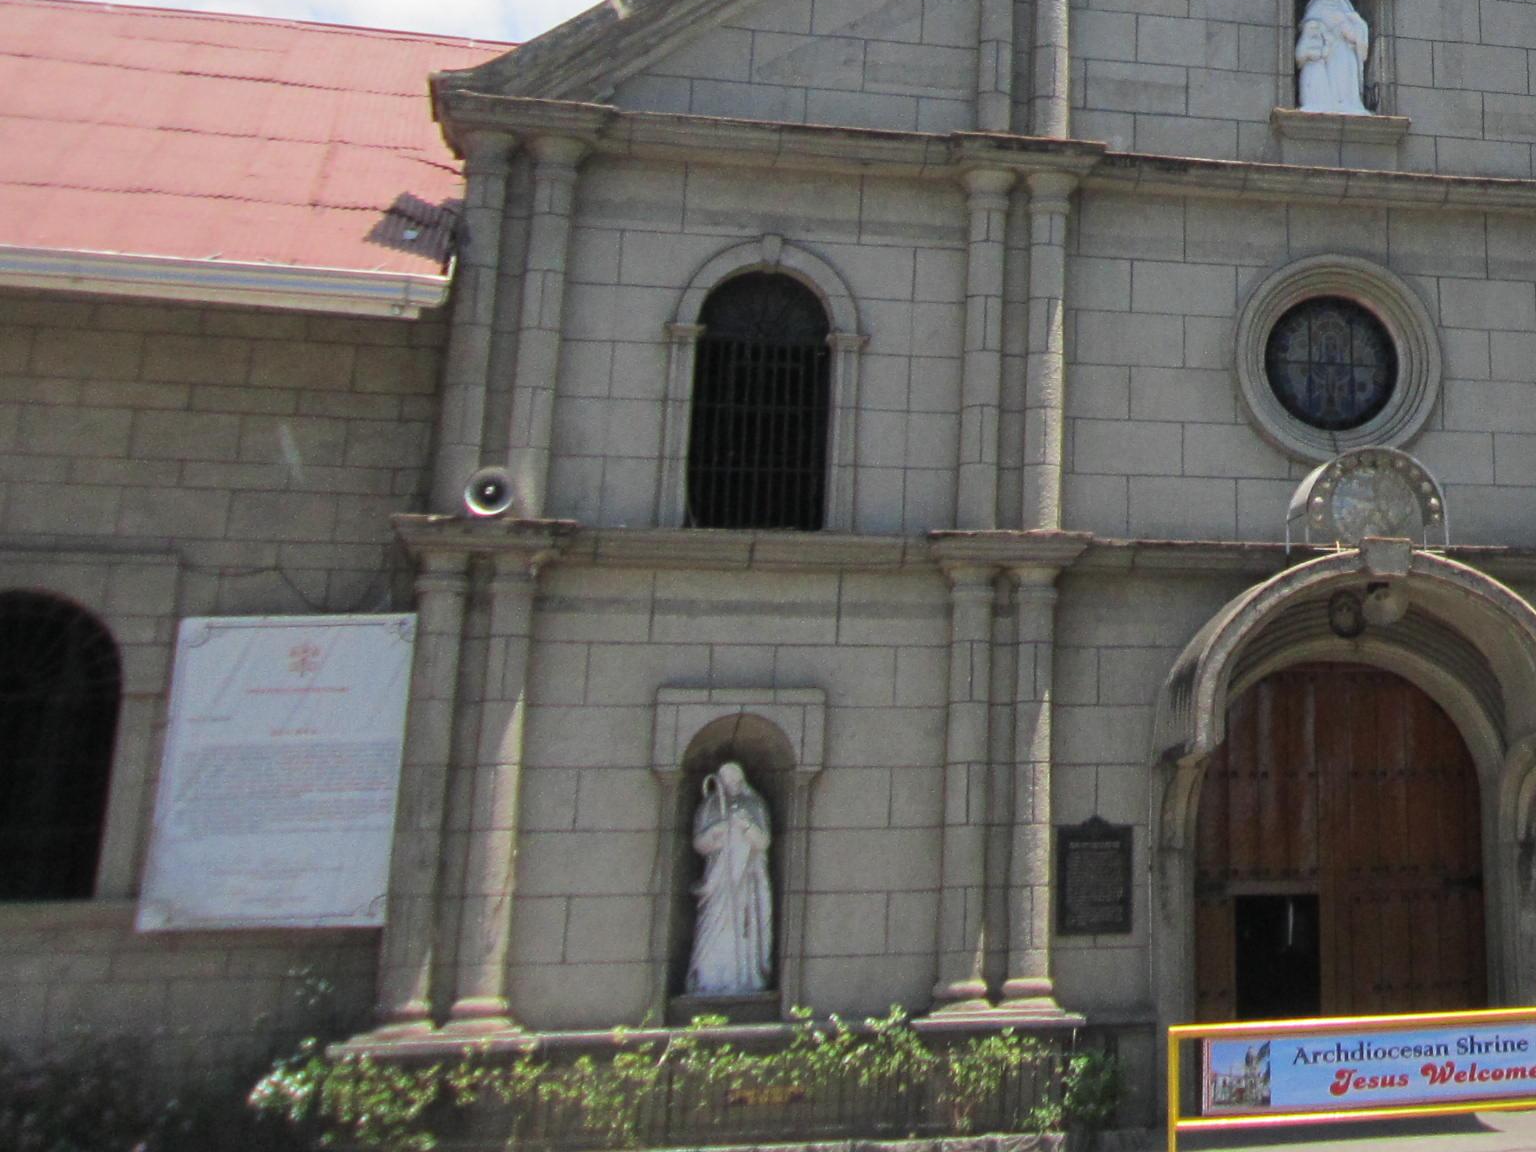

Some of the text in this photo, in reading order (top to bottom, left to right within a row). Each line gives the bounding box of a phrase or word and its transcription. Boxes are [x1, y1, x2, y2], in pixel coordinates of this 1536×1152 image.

[1292, 1040, 1449, 1066] Archdiocesan
[1456, 1034, 1529, 1056] Shrine
[1329, 1067, 1409, 1096] Jesus
